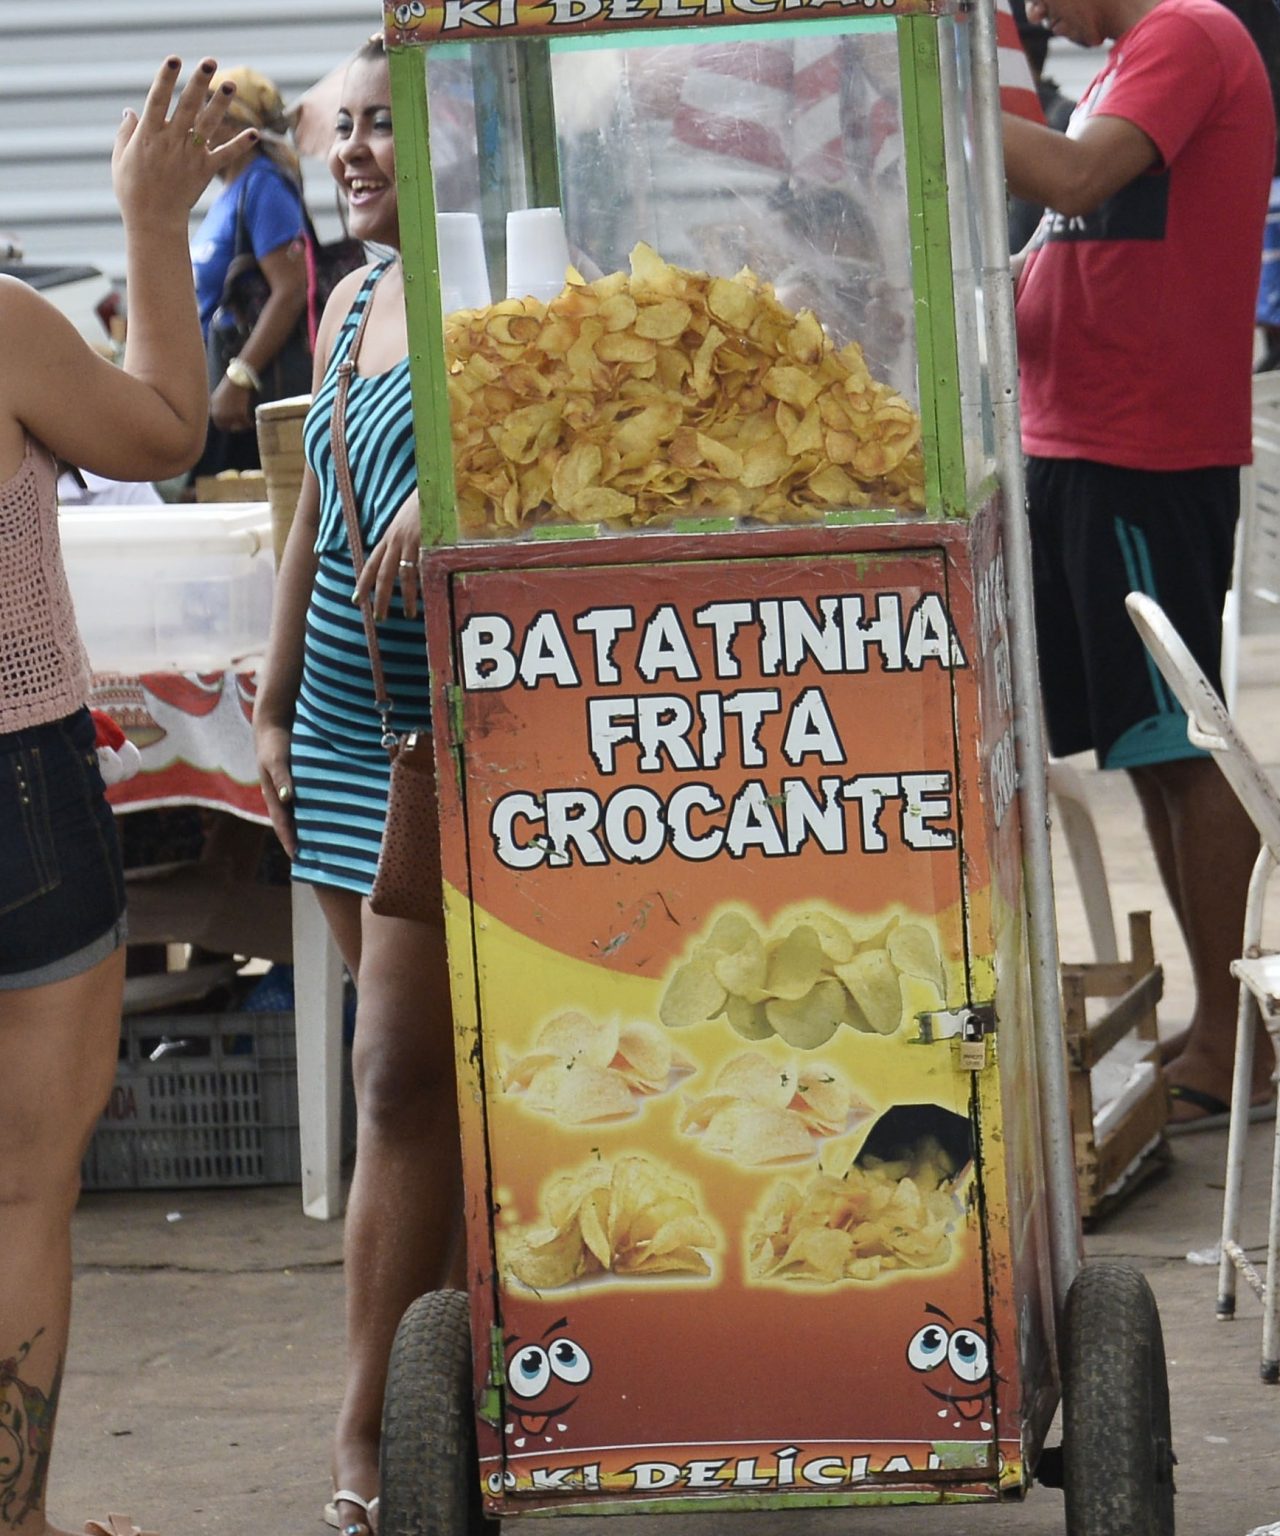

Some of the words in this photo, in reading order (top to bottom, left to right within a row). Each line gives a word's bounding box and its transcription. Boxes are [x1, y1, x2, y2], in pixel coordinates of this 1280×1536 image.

[461, 593, 967, 691] BATATINHA
[588, 686, 847, 774] FRITA
[490, 772, 958, 871] CROCANTE
[531, 1464, 600, 1490] KI
